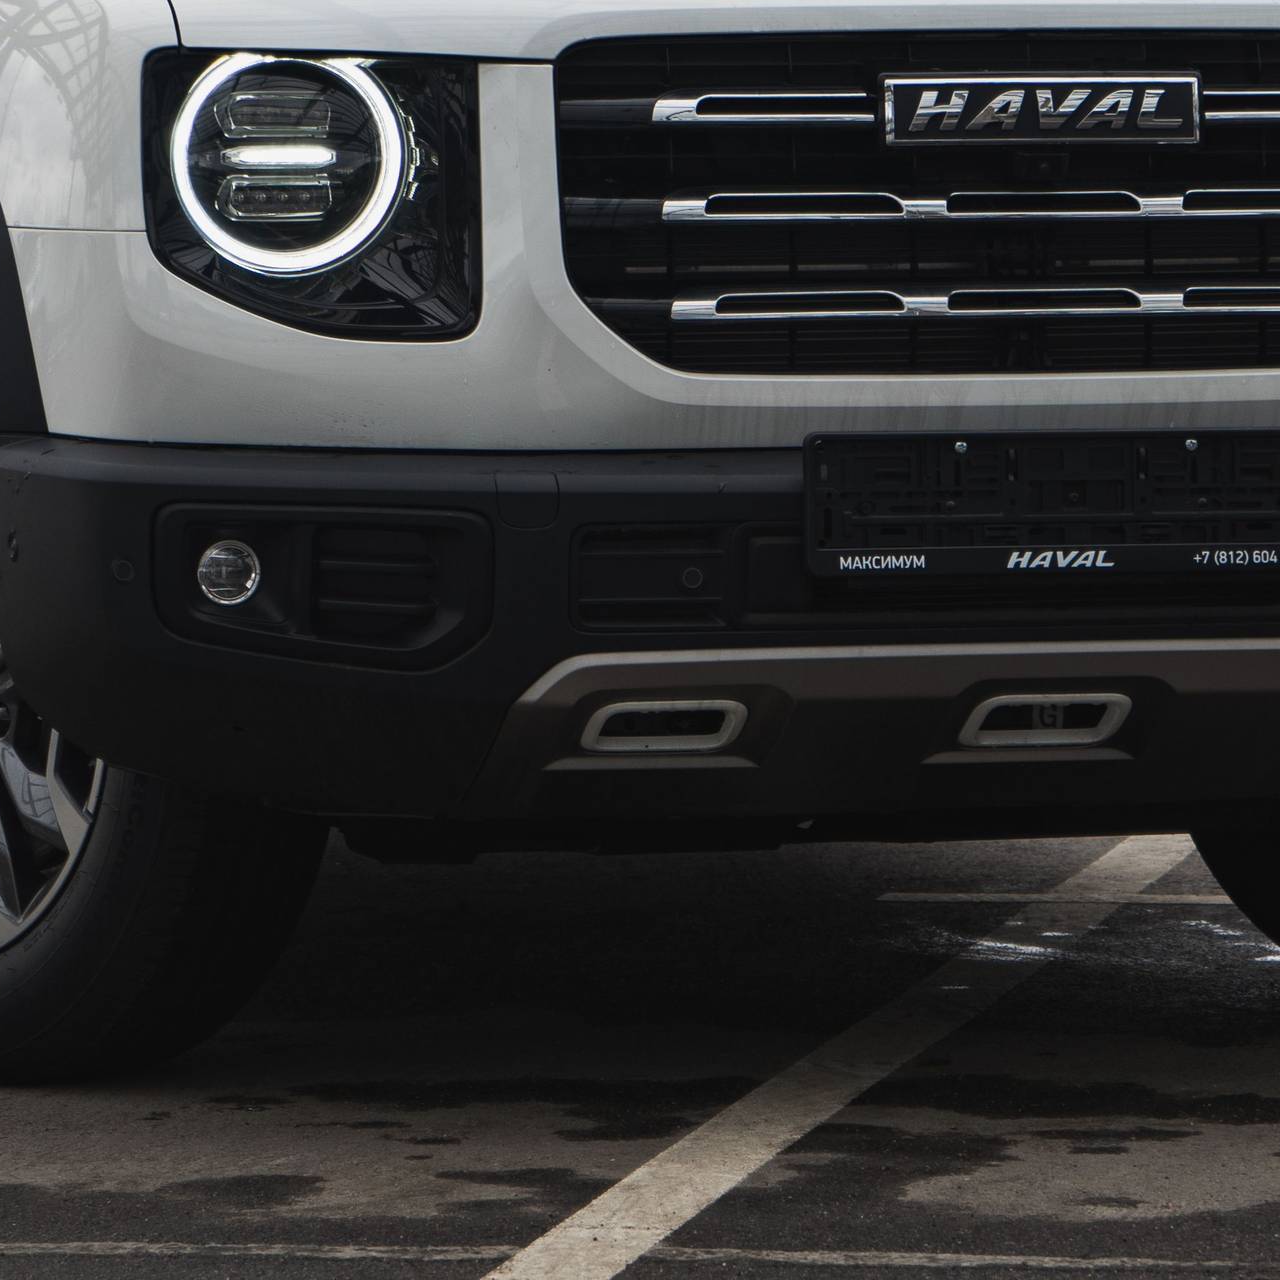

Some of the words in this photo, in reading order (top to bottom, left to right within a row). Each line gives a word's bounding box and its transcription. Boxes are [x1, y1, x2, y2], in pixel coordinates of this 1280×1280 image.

[908, 89, 1183, 132] HAVAL
[839, 554, 925, 570] МАКСИМУМ
[1006, 550, 1115, 569] HAVAL
[1193, 551, 1210, 564] +7
[1214, 550, 1249, 566] (812)
[1252, 549, 1278, 564] 604
